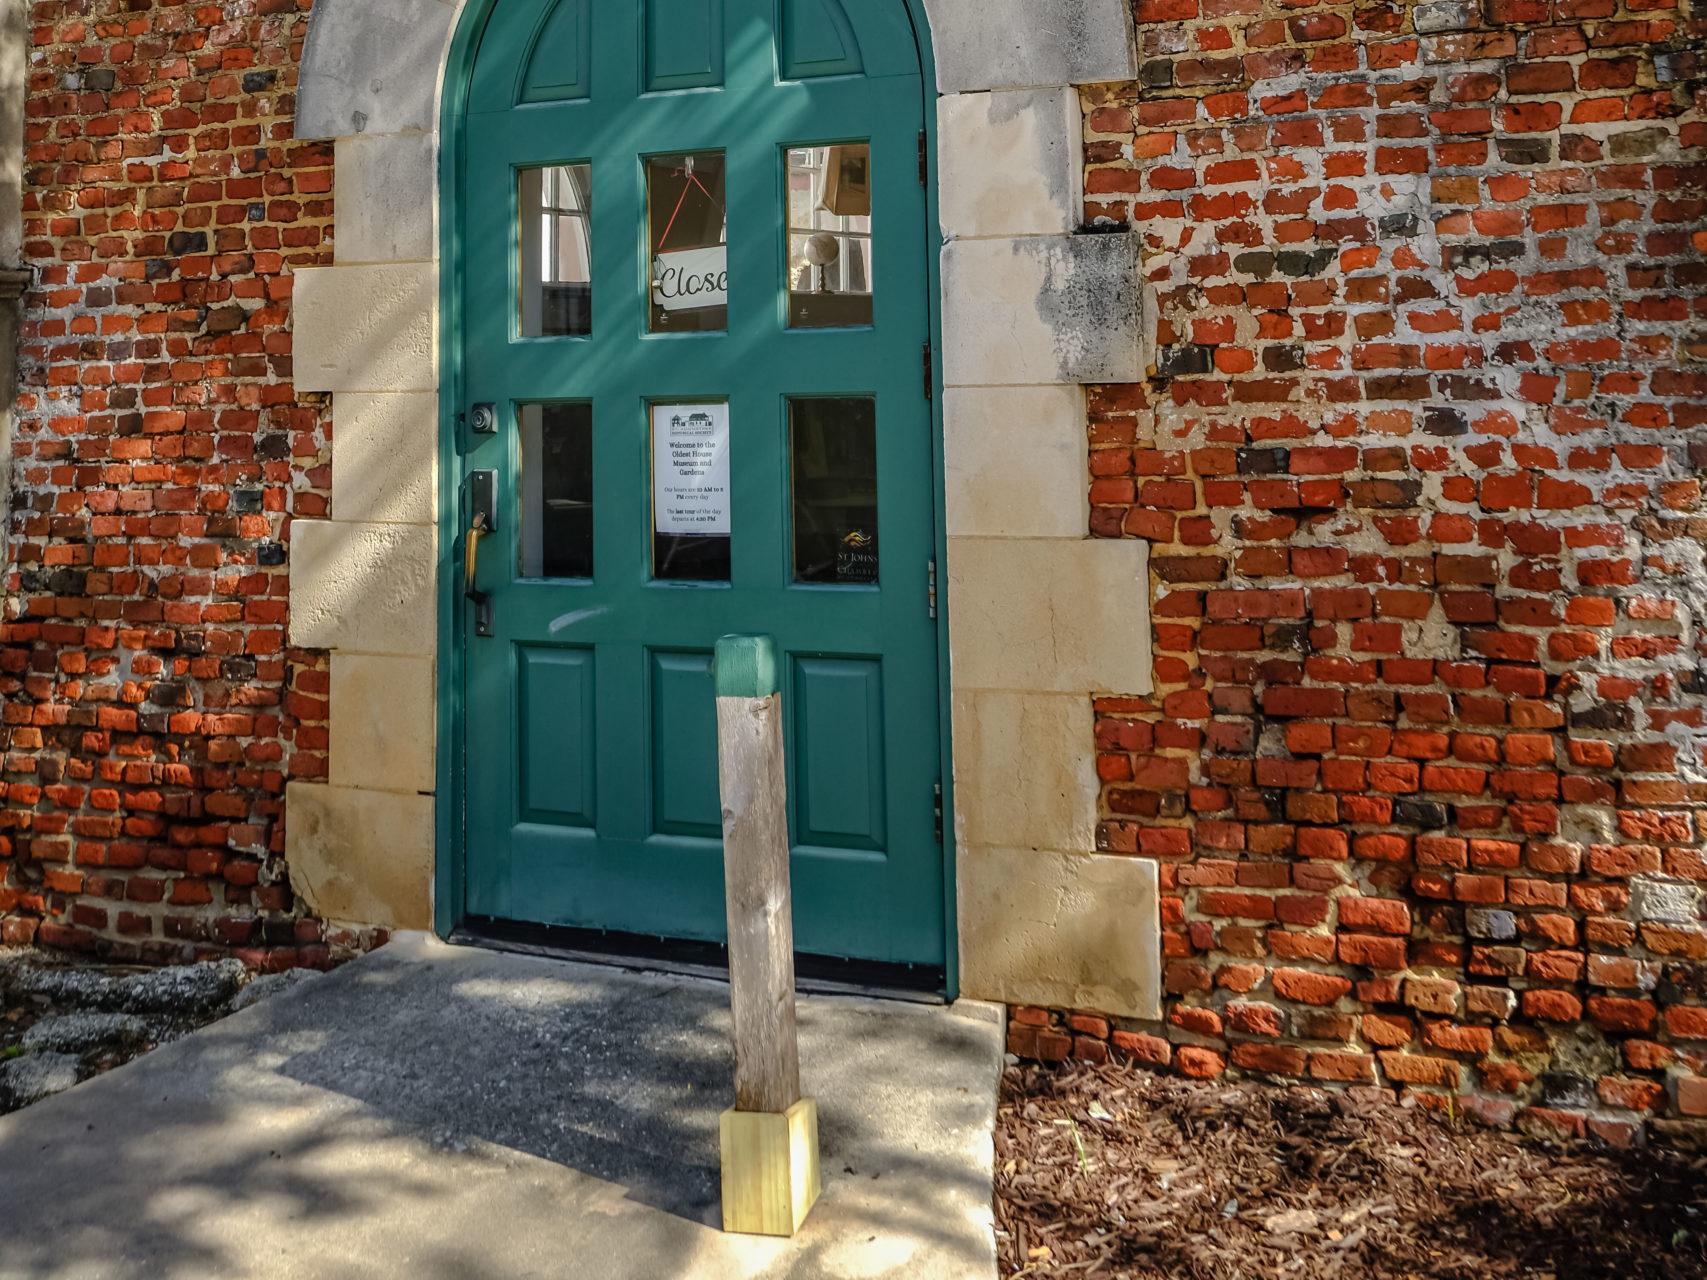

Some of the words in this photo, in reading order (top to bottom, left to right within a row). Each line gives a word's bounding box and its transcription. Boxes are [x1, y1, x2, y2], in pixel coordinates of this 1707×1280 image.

[669, 441, 696, 449] Welcome
[672, 450, 691, 458] Oldest
[692, 450, 713, 458] House
[673, 459, 699, 467] Museum
[679, 468, 705, 476] Gardens
